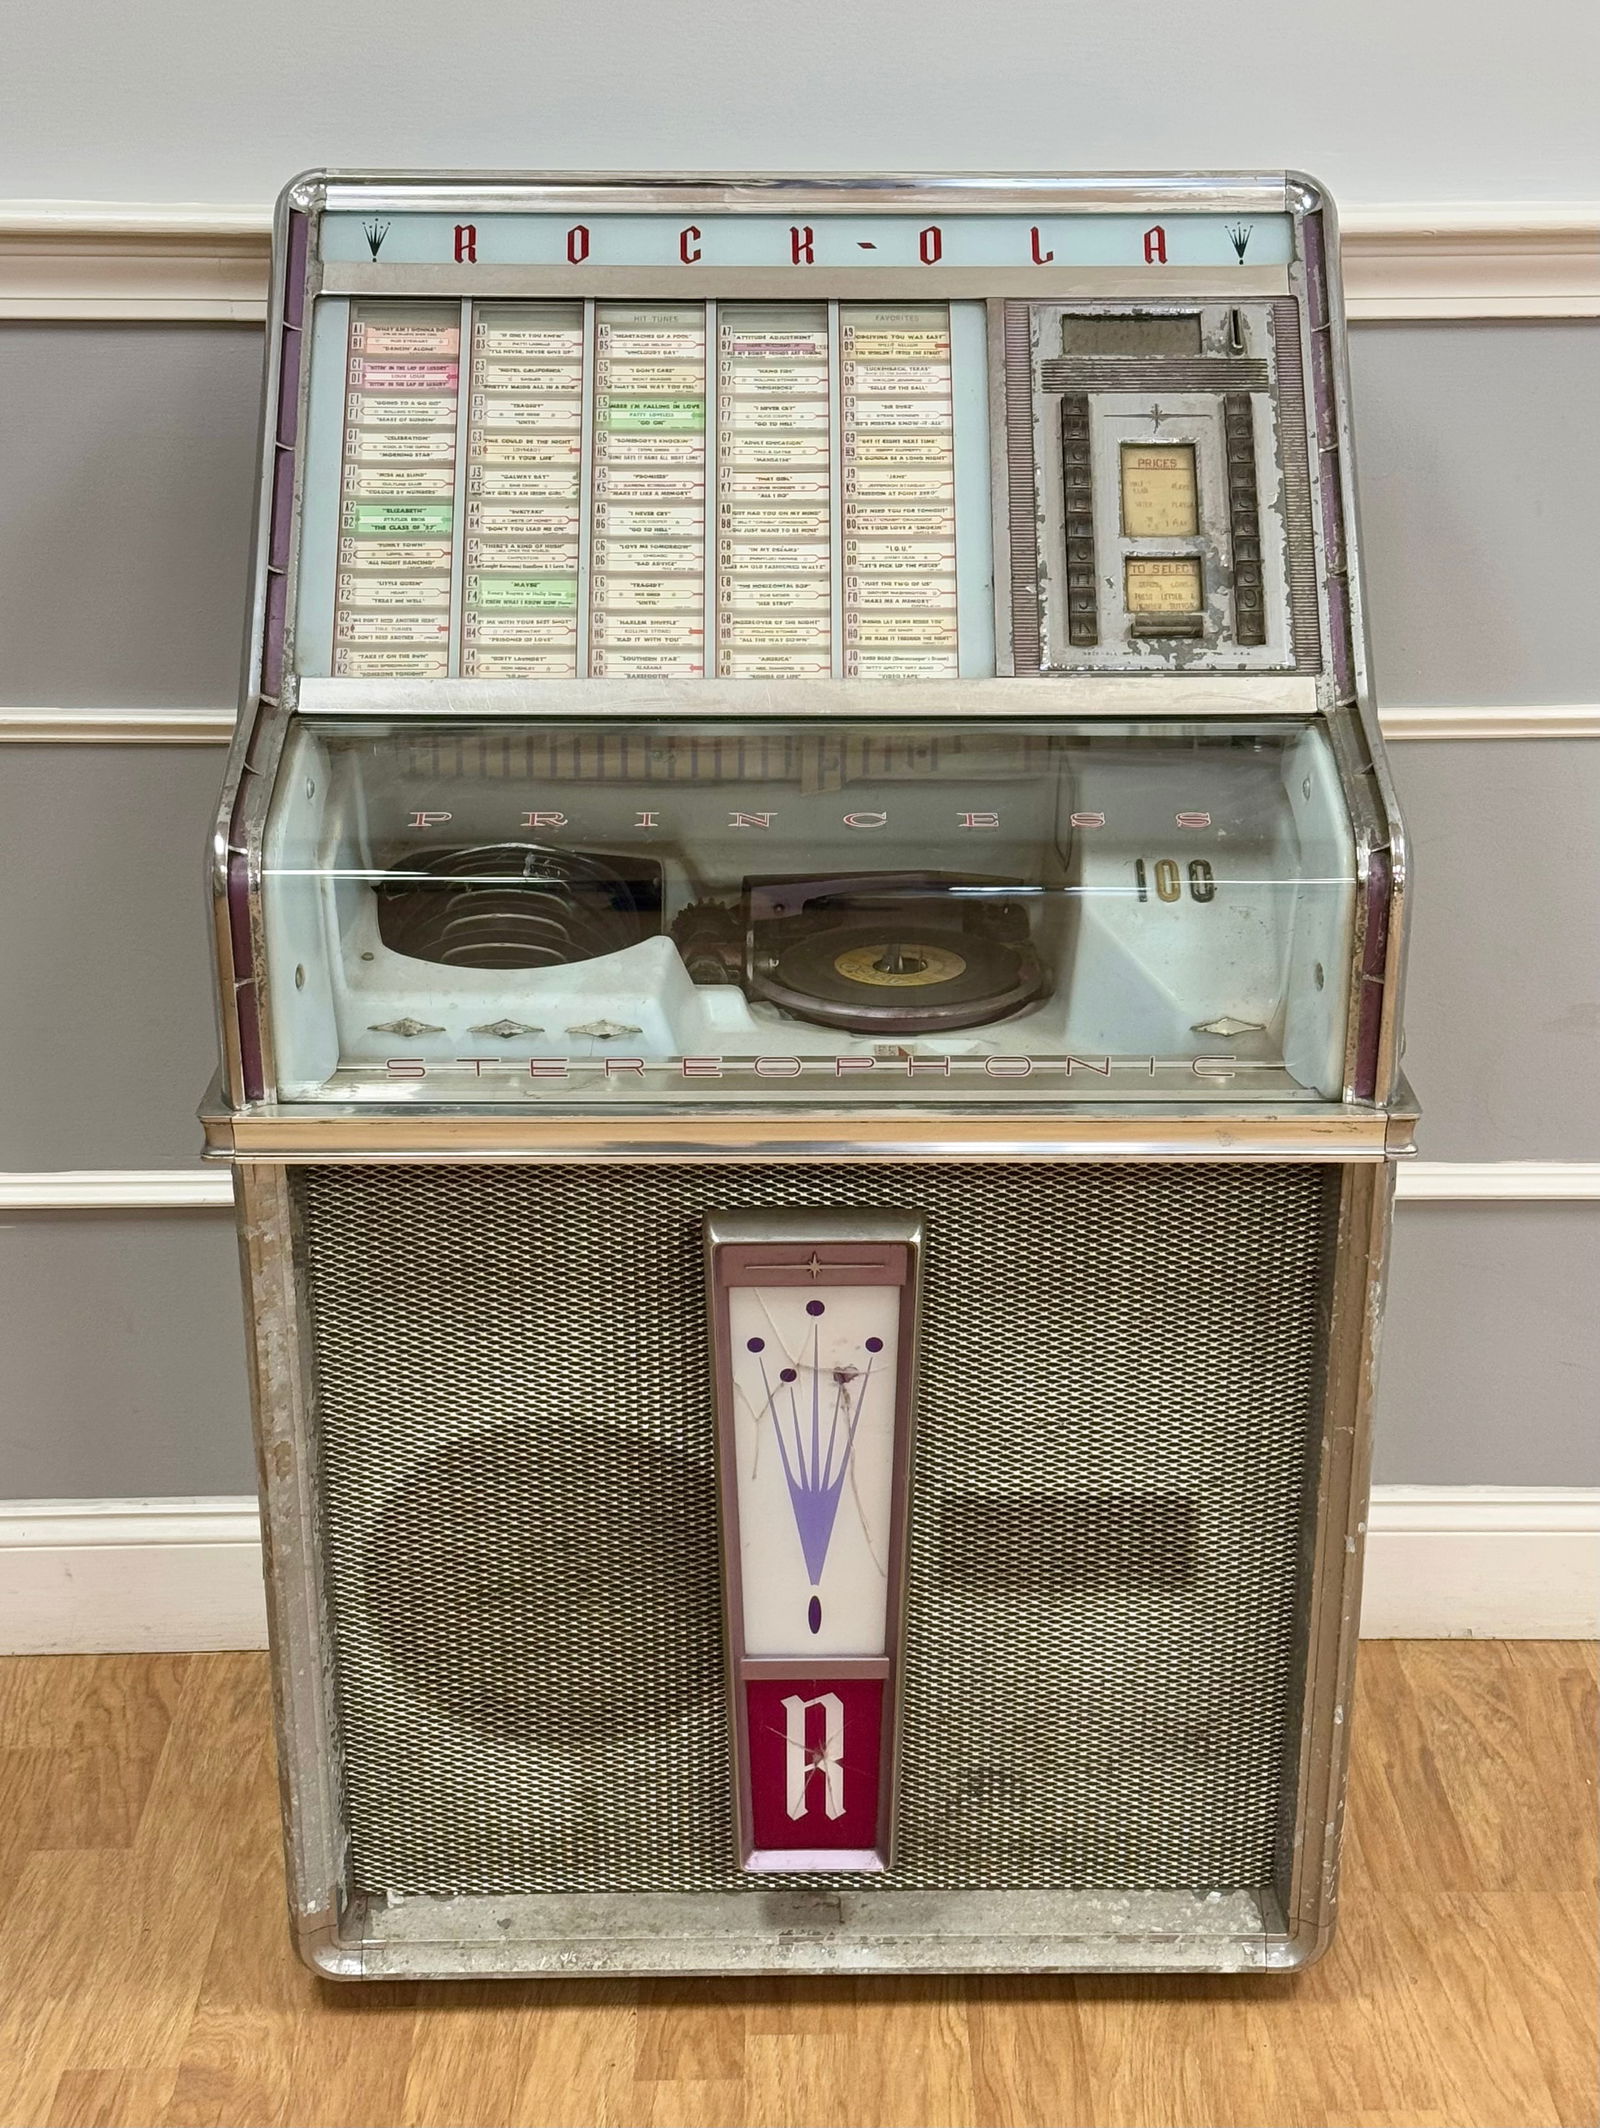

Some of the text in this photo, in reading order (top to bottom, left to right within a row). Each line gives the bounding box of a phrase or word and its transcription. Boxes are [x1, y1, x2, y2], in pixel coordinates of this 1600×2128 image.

[454, 226, 1168, 265] ROCK-OLA
[354, 324, 362, 333] A1
[476, 325, 486, 335] A3
[600, 326, 608, 336] A5
[722, 326, 731, 336] A7
[353, 338, 362, 348] B1
[476, 339, 485, 349] B3
[599, 340, 609, 350] B5
[722, 340, 731, 350] B7
[352, 359, 361, 369] C1
[475, 360, 485, 371] C3
[599, 361, 608, 372] C5
[721, 362, 731, 372] C7
[351, 373, 360, 383] D1
[475, 374, 484, 385] D3
[598, 376, 608, 386] D5
[721, 375, 731, 386] D7
[348, 430, 357, 440] G1
[1138, 458, 1177, 468] PRICES
[472, 467, 481, 477] J3
[597, 468, 607, 478] J5
[721, 468, 731, 478] J7
[471, 481, 481, 491] K3
[345, 502, 355, 512] A2
[596, 504, 606, 514] A6
[344, 516, 354, 527] B2
[596, 518, 606, 529] B6
[343, 538, 353, 549] C2
[469, 540, 478, 550] C4
[342, 552, 352, 563] D2
[468, 554, 478, 564] D4
[595, 555, 605, 565] D6
[1131, 564, 1197, 574] TO SELECT
[468, 590, 477, 601] F4
[595, 591, 604, 602] F6
[721, 591, 731, 602] F8
[721, 613, 731, 624] G8
[721, 628, 731, 638] H8
[721, 665, 731, 676] K8
[408, 811, 1212, 828] PRINCESS
[1136, 858, 1215, 903] 100
[386, 1056, 1237, 1078] STEREOPHONIC
